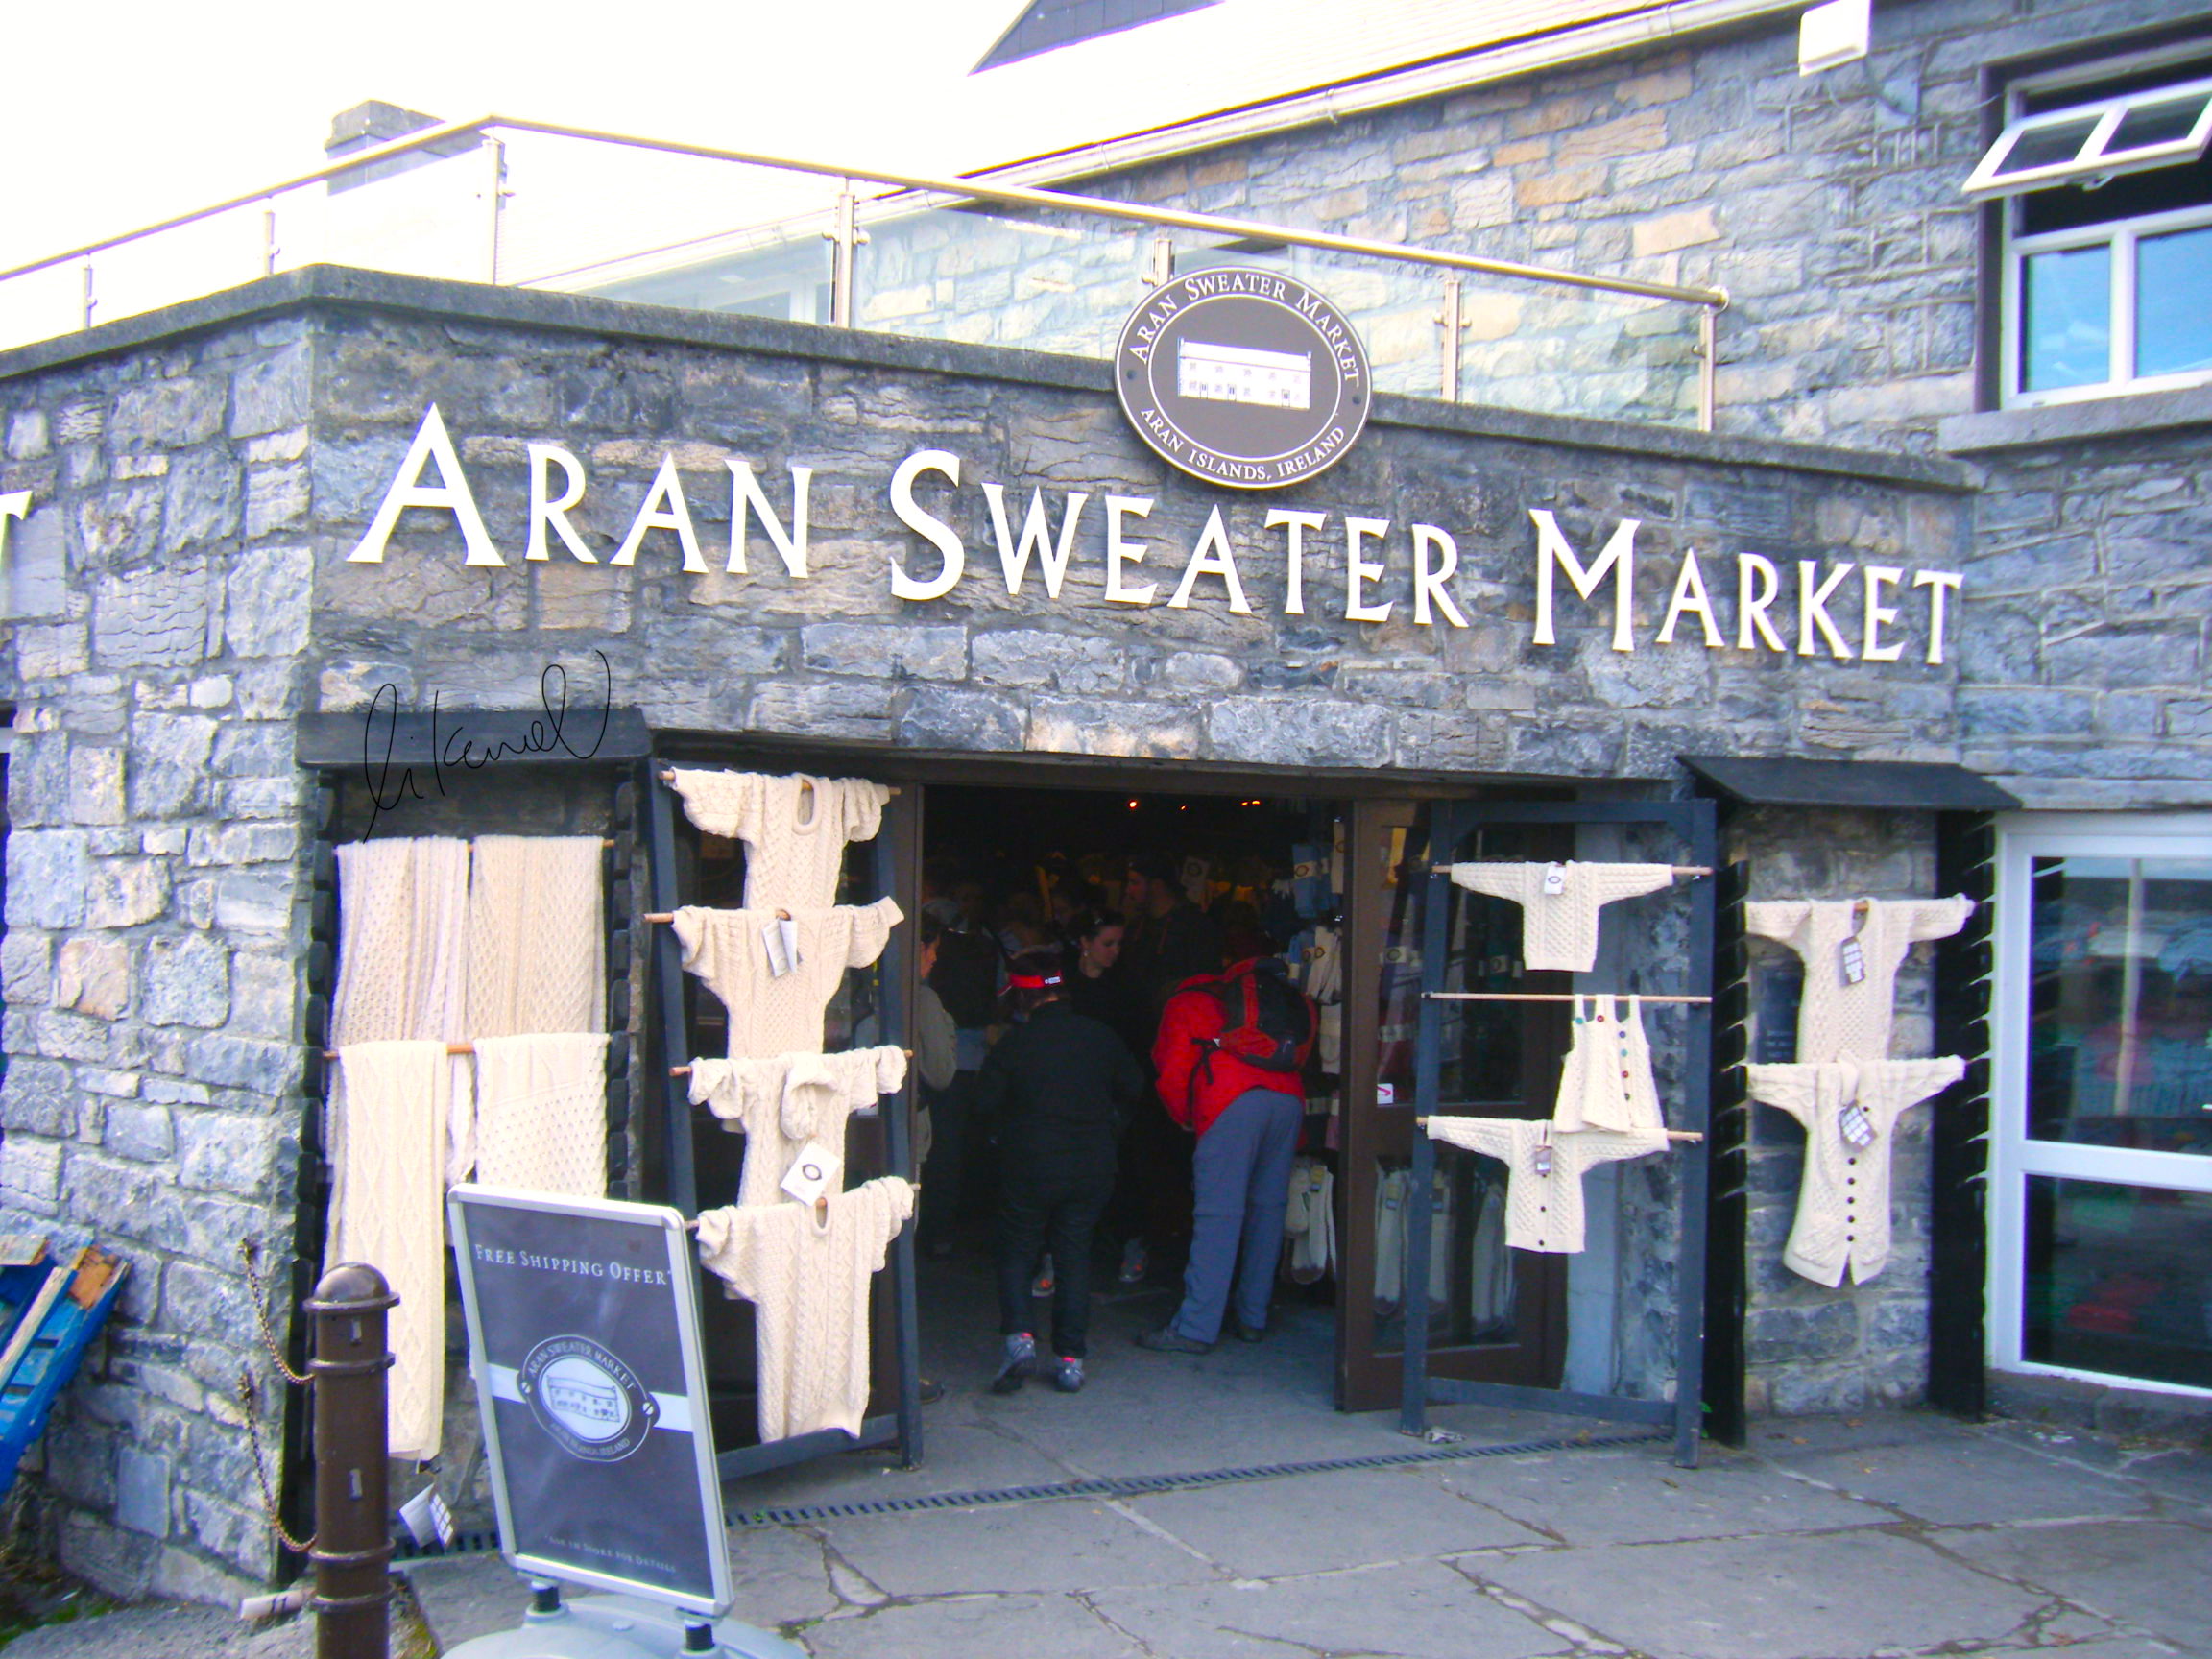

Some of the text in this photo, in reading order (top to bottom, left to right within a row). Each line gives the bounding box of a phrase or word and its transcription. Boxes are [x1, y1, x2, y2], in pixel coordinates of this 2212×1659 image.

[1129, 273, 1360, 388] ARAN SWEATER MARKET
[1141, 408, 1185, 454] ARAN
[1276, 425, 1345, 478] IRELAND
[347, 402, 1964, 665] ARAN SWEATER MARKET
[474, 1243, 516, 1265] FREE
[519, 1250, 604, 1278] SHIPPING
